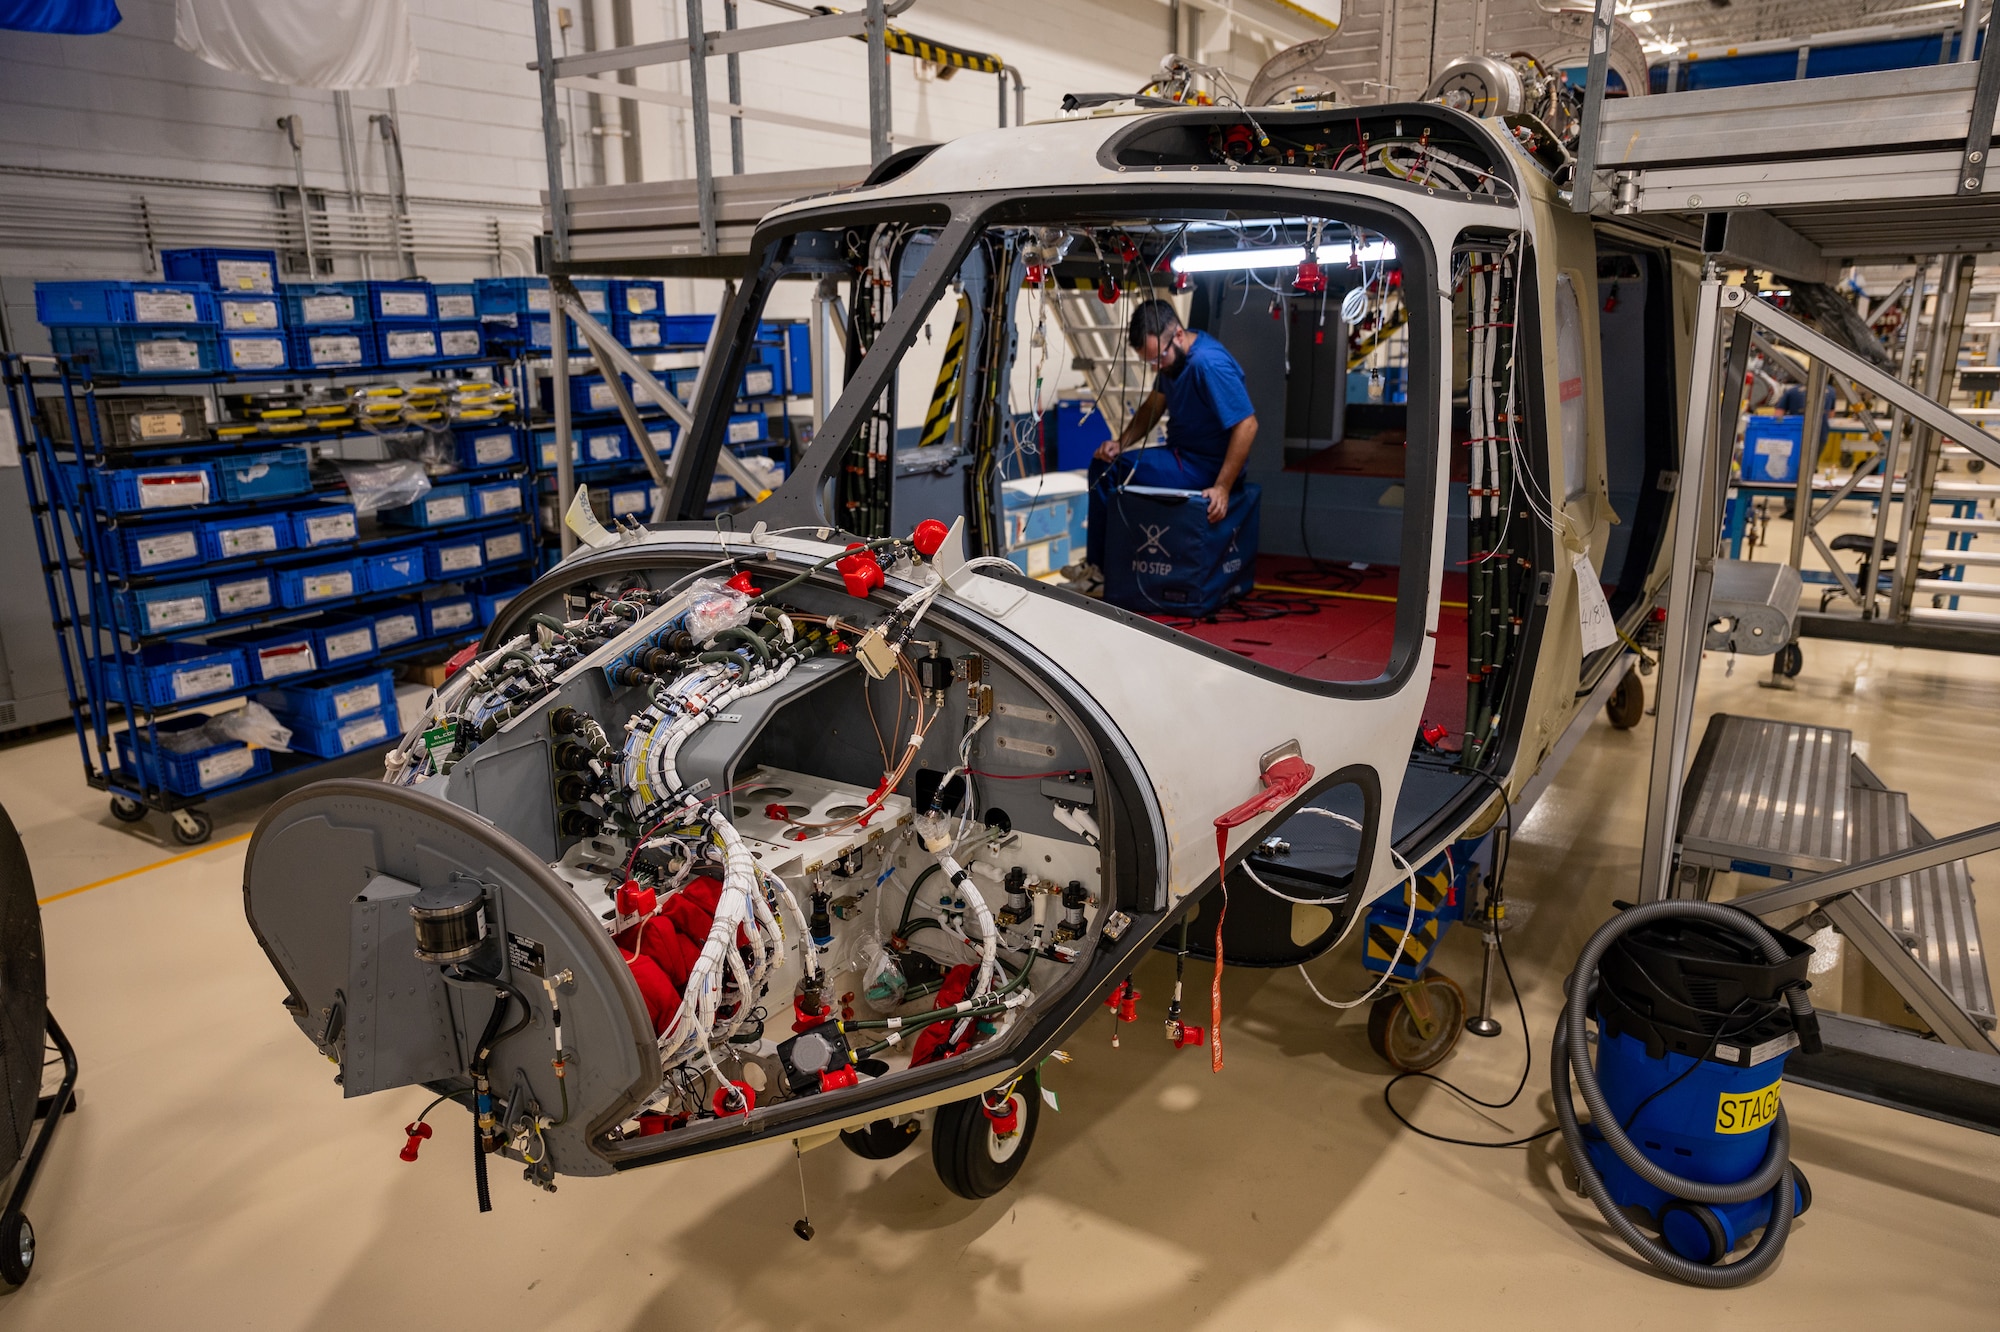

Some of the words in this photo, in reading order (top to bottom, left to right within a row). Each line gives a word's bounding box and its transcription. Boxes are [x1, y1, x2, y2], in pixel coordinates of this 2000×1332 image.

[1132, 560, 1147, 573] NO
[1149, 561, 1172, 576] STEP
[1719, 1083, 1781, 1129] STAGE
